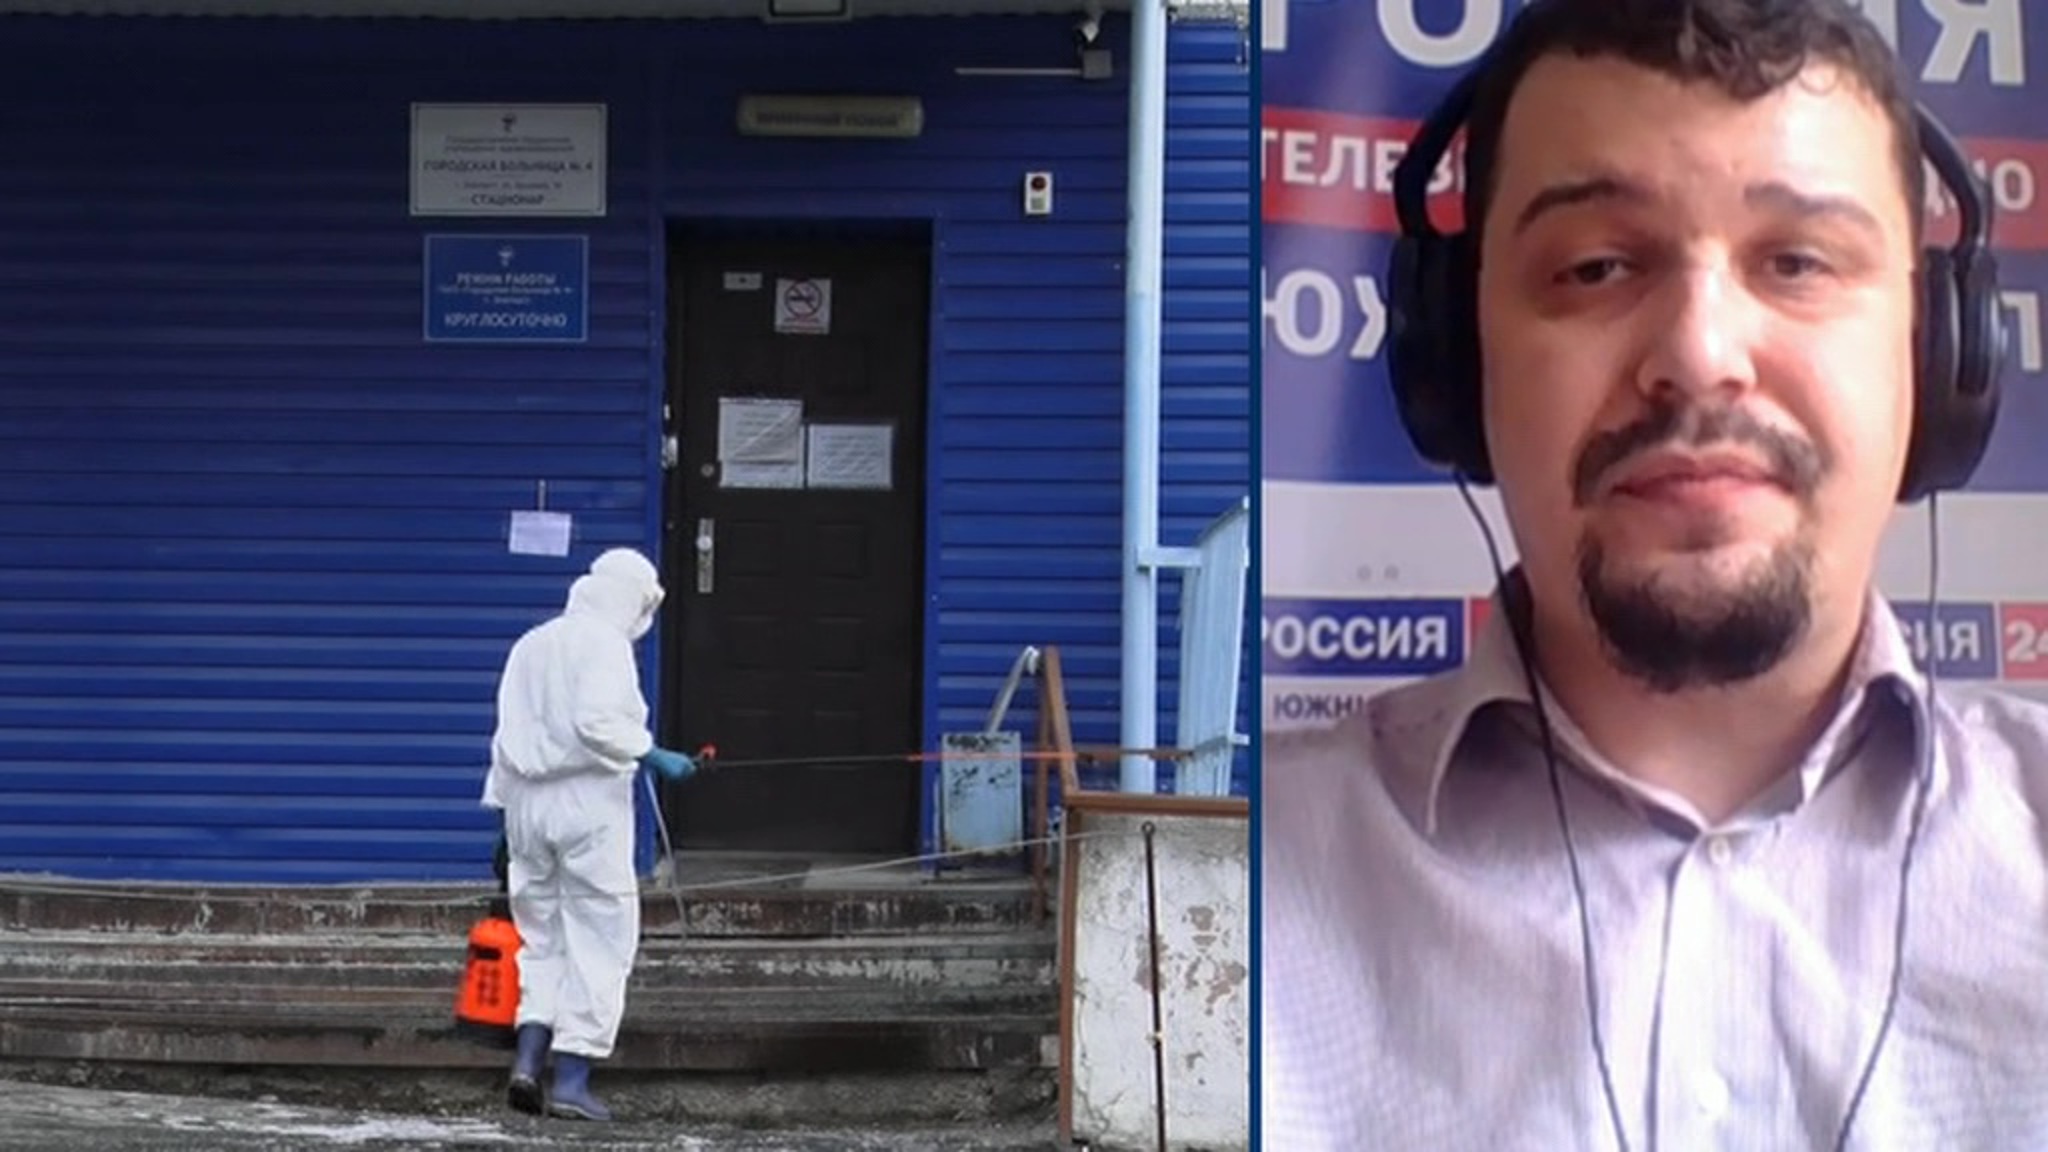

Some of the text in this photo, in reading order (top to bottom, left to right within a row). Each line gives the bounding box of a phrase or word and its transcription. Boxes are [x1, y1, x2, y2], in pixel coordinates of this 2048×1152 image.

[444, 312, 568, 327] КРУГЛОСУТОЧНО
[1262, 614, 1447, 660] ОССИЯ
[1273, 694, 1365, 719] ЮЖН
